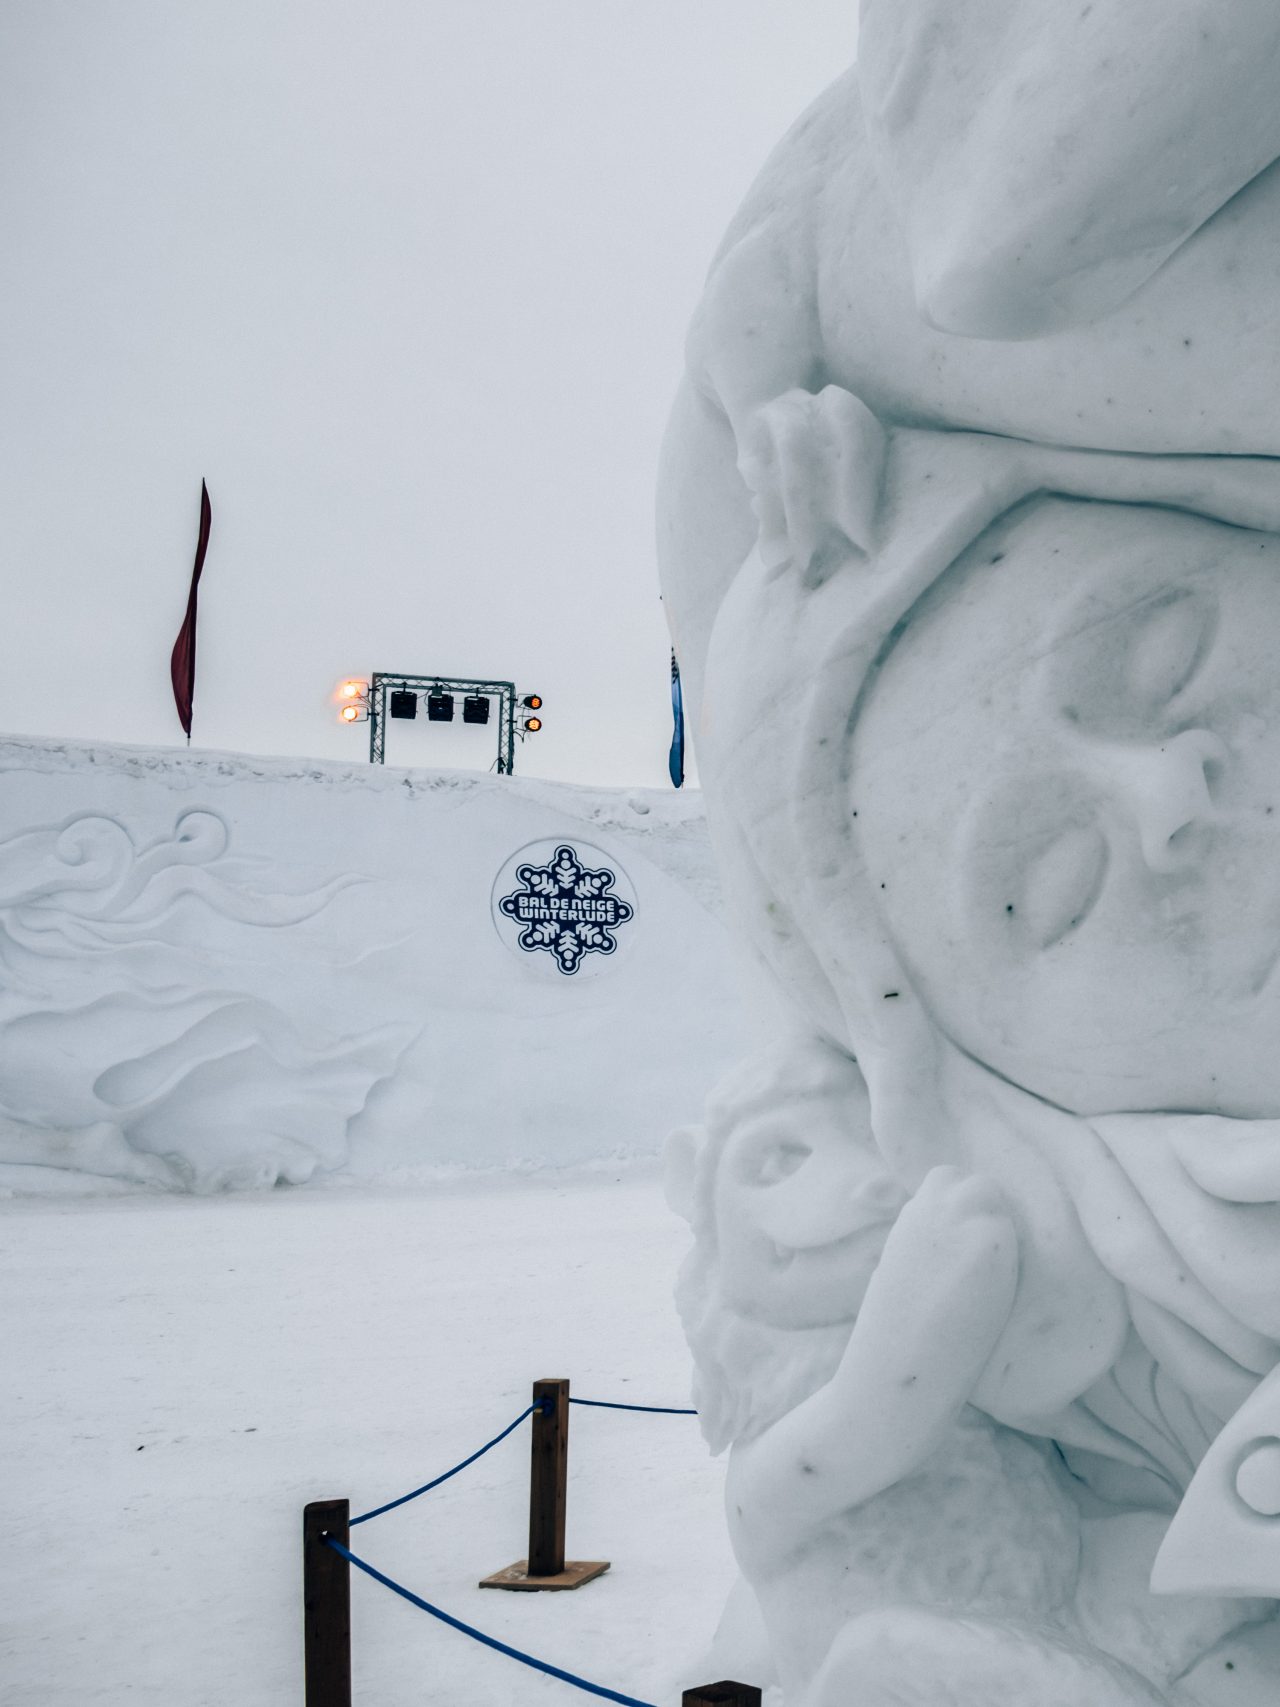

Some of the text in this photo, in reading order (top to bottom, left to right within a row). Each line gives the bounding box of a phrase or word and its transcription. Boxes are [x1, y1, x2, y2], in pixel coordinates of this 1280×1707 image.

[518, 896, 615, 911] BAL DE NEIGE
[518, 908, 615, 922] WINTERLUDE
